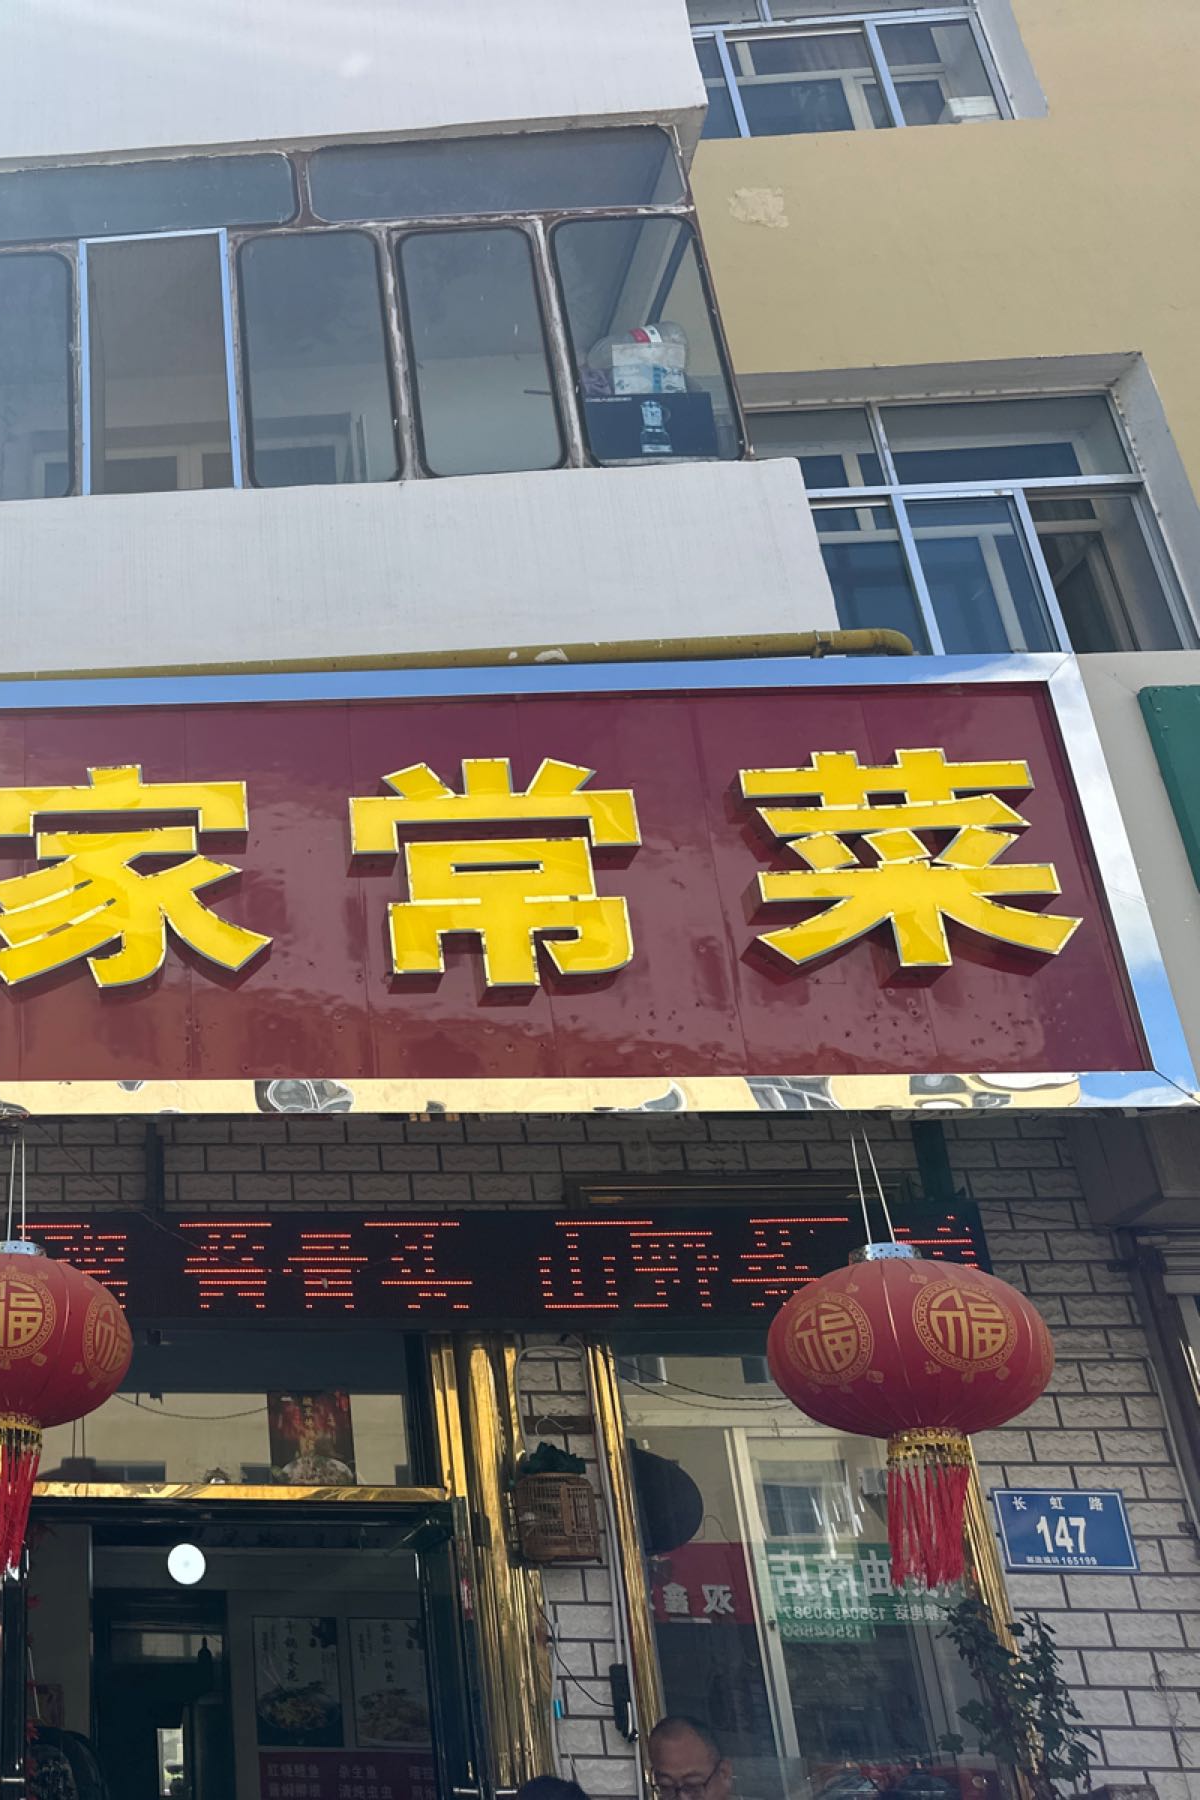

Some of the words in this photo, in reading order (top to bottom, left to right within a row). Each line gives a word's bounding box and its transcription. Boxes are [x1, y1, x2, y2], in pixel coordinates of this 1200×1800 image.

[795, 1302, 857, 1373] 福
[930, 1288, 1008, 1360] 福
[1012, 1496, 1103, 1511] 长虹路
[1036, 1515, 1086, 1553] 147
